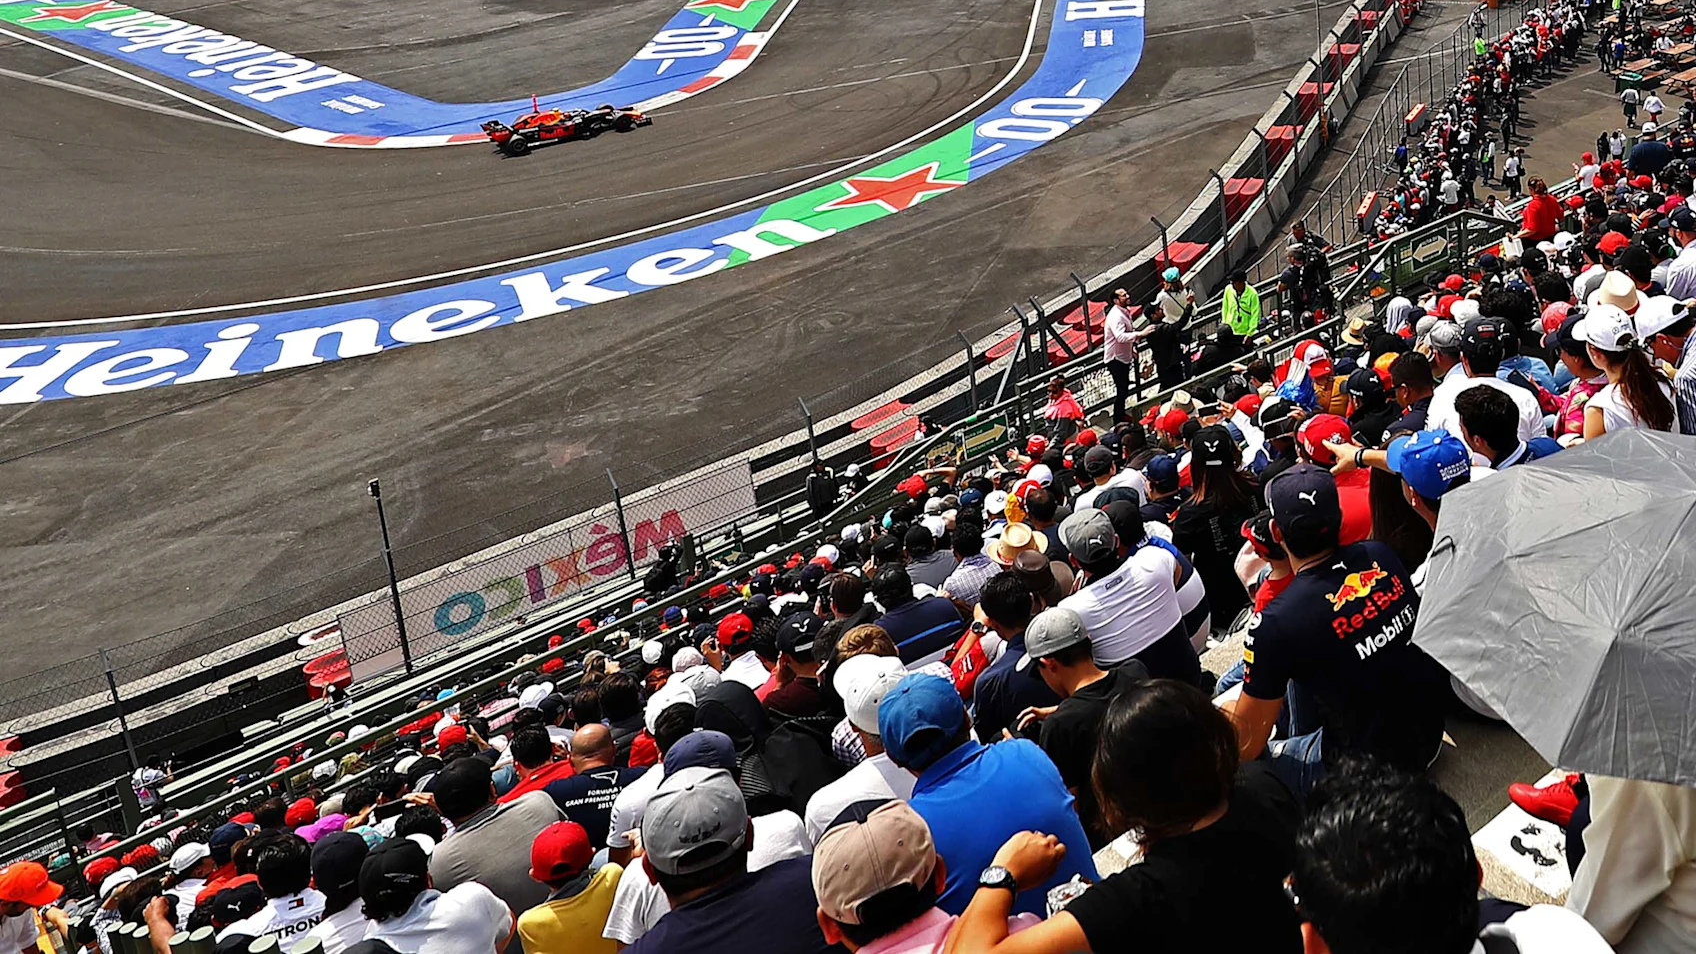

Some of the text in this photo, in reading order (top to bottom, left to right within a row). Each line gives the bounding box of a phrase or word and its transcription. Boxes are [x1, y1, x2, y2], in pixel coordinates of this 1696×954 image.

[85, 11, 363, 103] Heineken
[0, 219, 838, 404] Heineken
[1355, 615, 1404, 660] Mobil
[565, 798, 584, 808] GRAN
[585, 794, 610, 805] PREMIO
[587, 787, 618, 797] FORMULA
